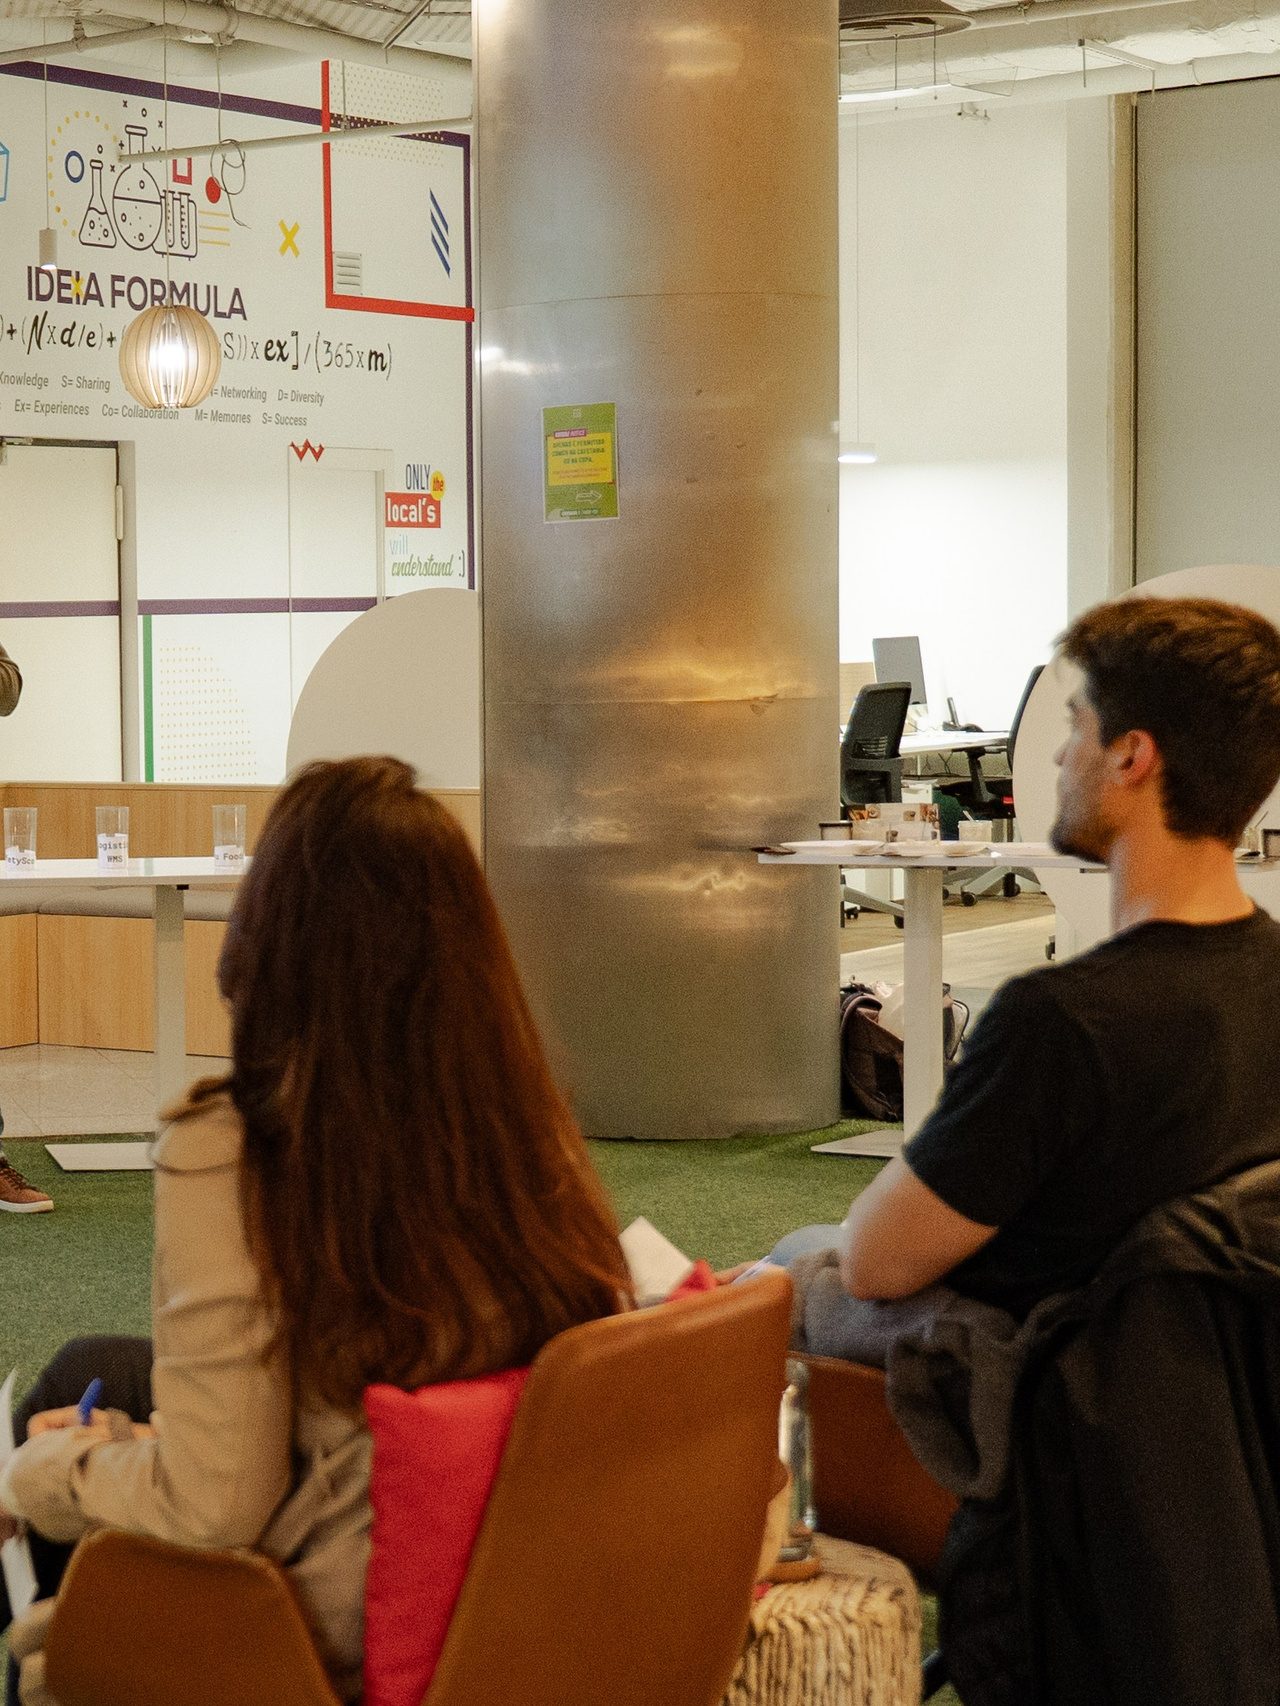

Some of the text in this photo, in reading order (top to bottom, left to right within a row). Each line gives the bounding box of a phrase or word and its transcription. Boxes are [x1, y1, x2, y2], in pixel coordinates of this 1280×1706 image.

[110, 274, 248, 321] FORMULA
[76, 376, 111, 393] Sharing
[220, 386, 267, 403] Networking
[291, 389, 325, 407] Diversity
[34, 400, 90, 416] Experiences
[121, 405, 180, 420] Collaboration
[210, 409, 252, 424] Memories
[275, 412, 308, 427] Success
[405, 464, 445, 492] ONLY the
[387, 497, 437, 523] local's
[389, 534, 409, 555] will
[391, 553, 455, 577] understand
